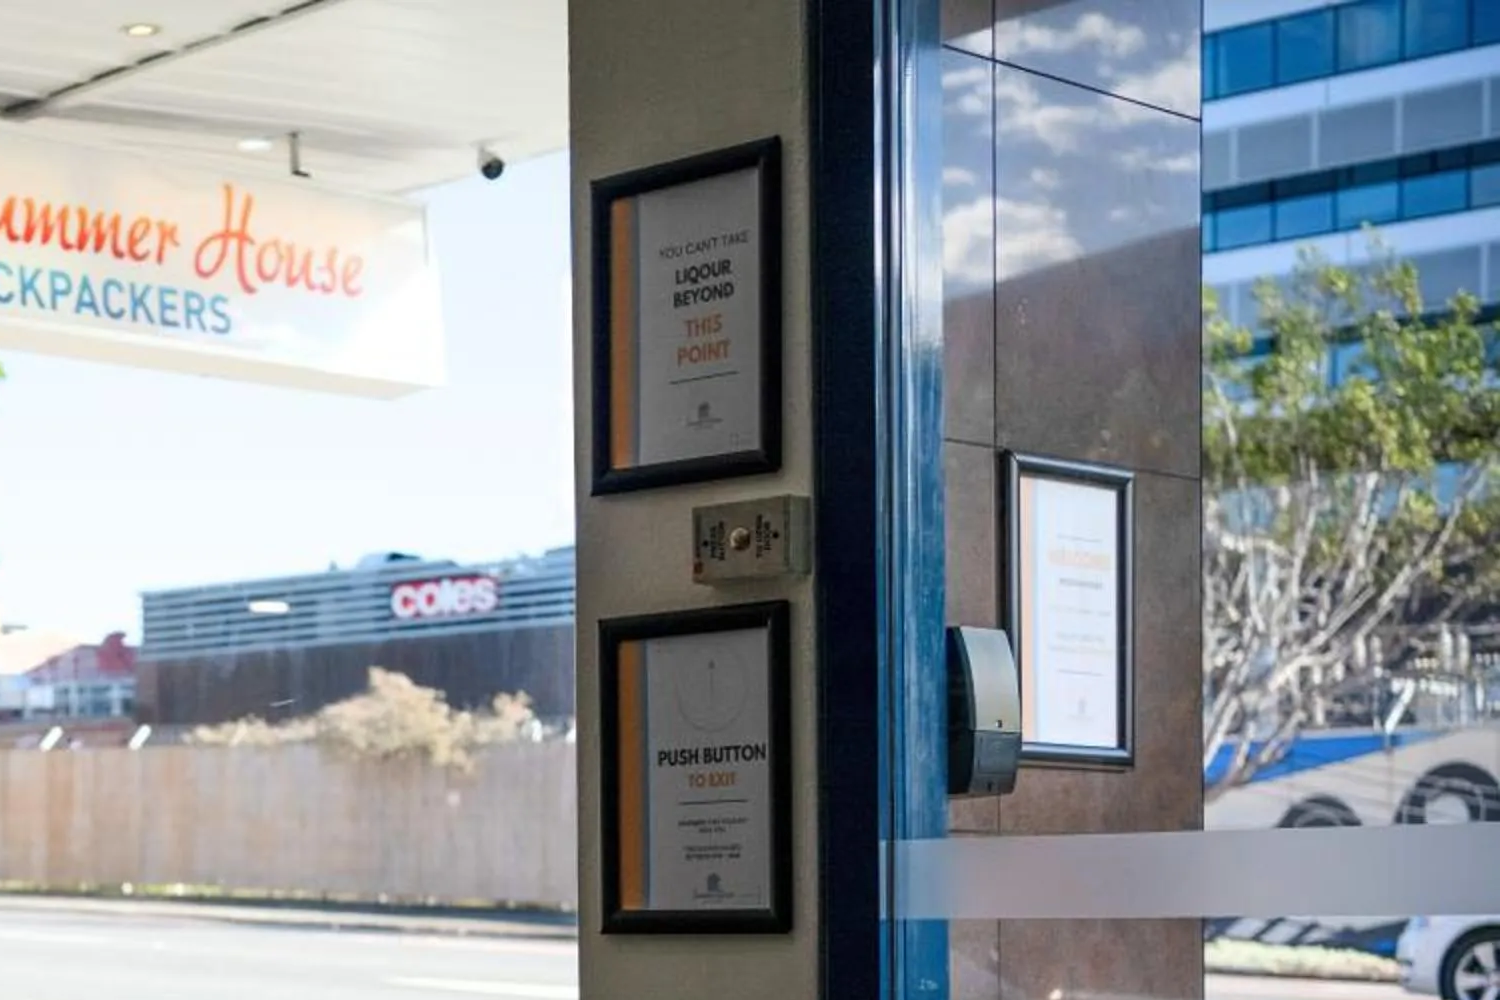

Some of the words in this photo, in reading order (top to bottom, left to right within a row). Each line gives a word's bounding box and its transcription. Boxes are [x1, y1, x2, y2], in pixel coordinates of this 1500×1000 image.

[194, 182, 366, 297] House
[659, 246, 683, 259] YOU
[721, 230, 751, 248] TAKE
[675, 259, 733, 285] LIQOUR
[673, 281, 735, 309] BEYOND
[684, 313, 723, 337] THIS
[677, 338, 732, 368] POINT
[390, 579, 498, 618] coles
[657, 747, 699, 767] PUSH
[703, 742, 766, 764] BUTTON
[687, 773, 706, 788] TO
[708, 771, 736, 788] EXIT
